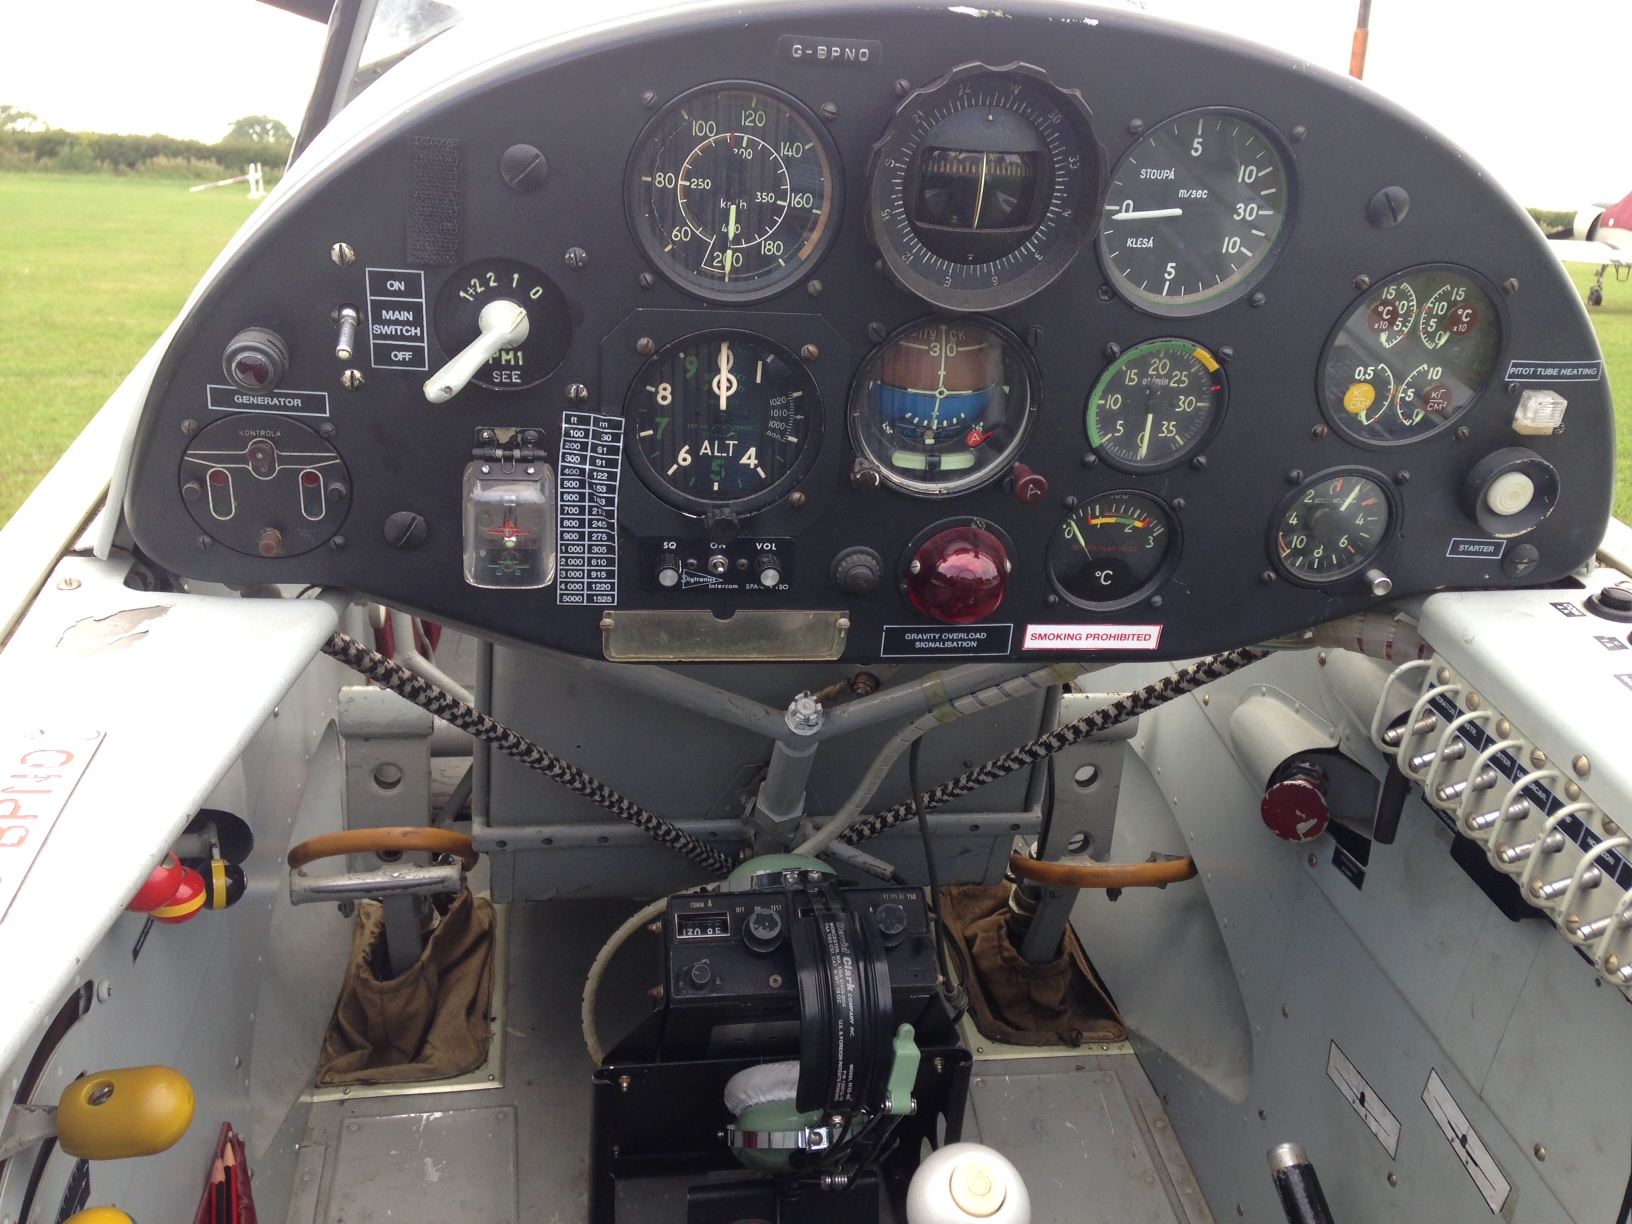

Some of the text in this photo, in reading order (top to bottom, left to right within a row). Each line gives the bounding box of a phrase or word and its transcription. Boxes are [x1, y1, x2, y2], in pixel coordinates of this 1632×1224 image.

[792, 44, 869, 62] G-BPNO
[741, 110, 766, 127] 120
[692, 120, 717, 137] 100
[780, 142, 803, 158] 140
[1190, 138, 1203, 157] 5
[1069, 155, 1080, 169] 33
[655, 172, 675, 188] 80
[1139, 167, 1175, 180] STOUPÁ
[1237, 165, 1257, 183] 10
[690, 178, 712, 190] 250
[755, 192, 775, 203] 350
[790, 192, 813, 208] 160
[1178, 189, 1208, 198] m/sec
[1121, 199, 1134, 214] 0
[1233, 203, 1257, 221] 30
[671, 226, 691, 242] 60
[761, 241, 783, 257] 180
[1126, 237, 1154, 248] KLESÁ
[1221, 237, 1240, 254] 10
[1164, 262, 1176, 280] 5
[386, 280, 405, 291] ON
[486, 272, 498, 287] 2
[512, 273, 519, 289] 1
[529, 286, 543, 300] 0
[1382, 286, 1397, 300] 15
[1451, 287, 1466, 300] 15
[1433, 302, 1448, 315] 10
[382, 310, 413, 321] MAIN
[1394, 318, 1403, 330] 5
[1427, 319, 1437, 332] 5
[372, 325, 421, 337] SWITCH
[390, 351, 412, 361] OFF
[684, 356, 698, 379] 9
[756, 361, 763, 383] 1
[1148, 359, 1170, 375] 20
[1354, 366, 1375, 380] 0,5
[1427, 367, 1442, 380] 10
[1509, 367, 1597, 376] PITOT TUBE HEATING
[492, 371, 522, 383] SEE
[1125, 369, 1138, 385] 15
[1169, 371, 1189, 388] 25
[656, 383, 672, 405] 8
[1405, 389, 1415, 401] 5
[234, 395, 302, 407] GENERATOR
[770, 396, 787, 406] 1020
[1106, 394, 1122, 410] 10
[1175, 396, 1196, 412] 30
[770, 409, 788, 417] 1010
[570, 416, 578, 424] ft
[769, 420, 786, 430] 1000
[655, 418, 670, 440] 7
[1114, 420, 1124, 437] 5
[1158, 421, 1177, 437] 35
[564, 442, 580, 450] 200
[699, 439, 738, 456] ALT
[564, 455, 580, 463] 300
[677, 445, 692, 466] 6
[739, 447, 758, 468] 4
[592, 472, 608, 480] 122
[710, 460, 725, 481] 5
[563, 480, 579, 488] 500
[593, 484, 607, 492] 153
[563, 493, 579, 501] 600
[1027, 483, 1041, 499] A
[1304, 489, 1315, 503] 2
[592, 520, 607, 528] 245
[1289, 512, 1298, 525] 4
[1355, 512, 1364, 526] 4
[592, 533, 607, 541] 275
[1064, 526, 1074, 539] 0
[663, 541, 677, 550] SQ
[755, 542, 777, 550] VOL
[1145, 536, 1154, 548] 3
[1291, 535, 1307, 548] 10
[1339, 534, 1348, 547] 6
[1458, 544, 1495, 553] STARTER
[942, 632, 987, 640] OVERLOAD
[1030, 632, 1152, 642] SMOKING PROHIBITED
[915, 640, 977, 649] SIGNALISATION
[836, 921, 850, 954] David
[842, 956, 855, 991] Clark
[847, 993, 855, 1025] COMPANY
